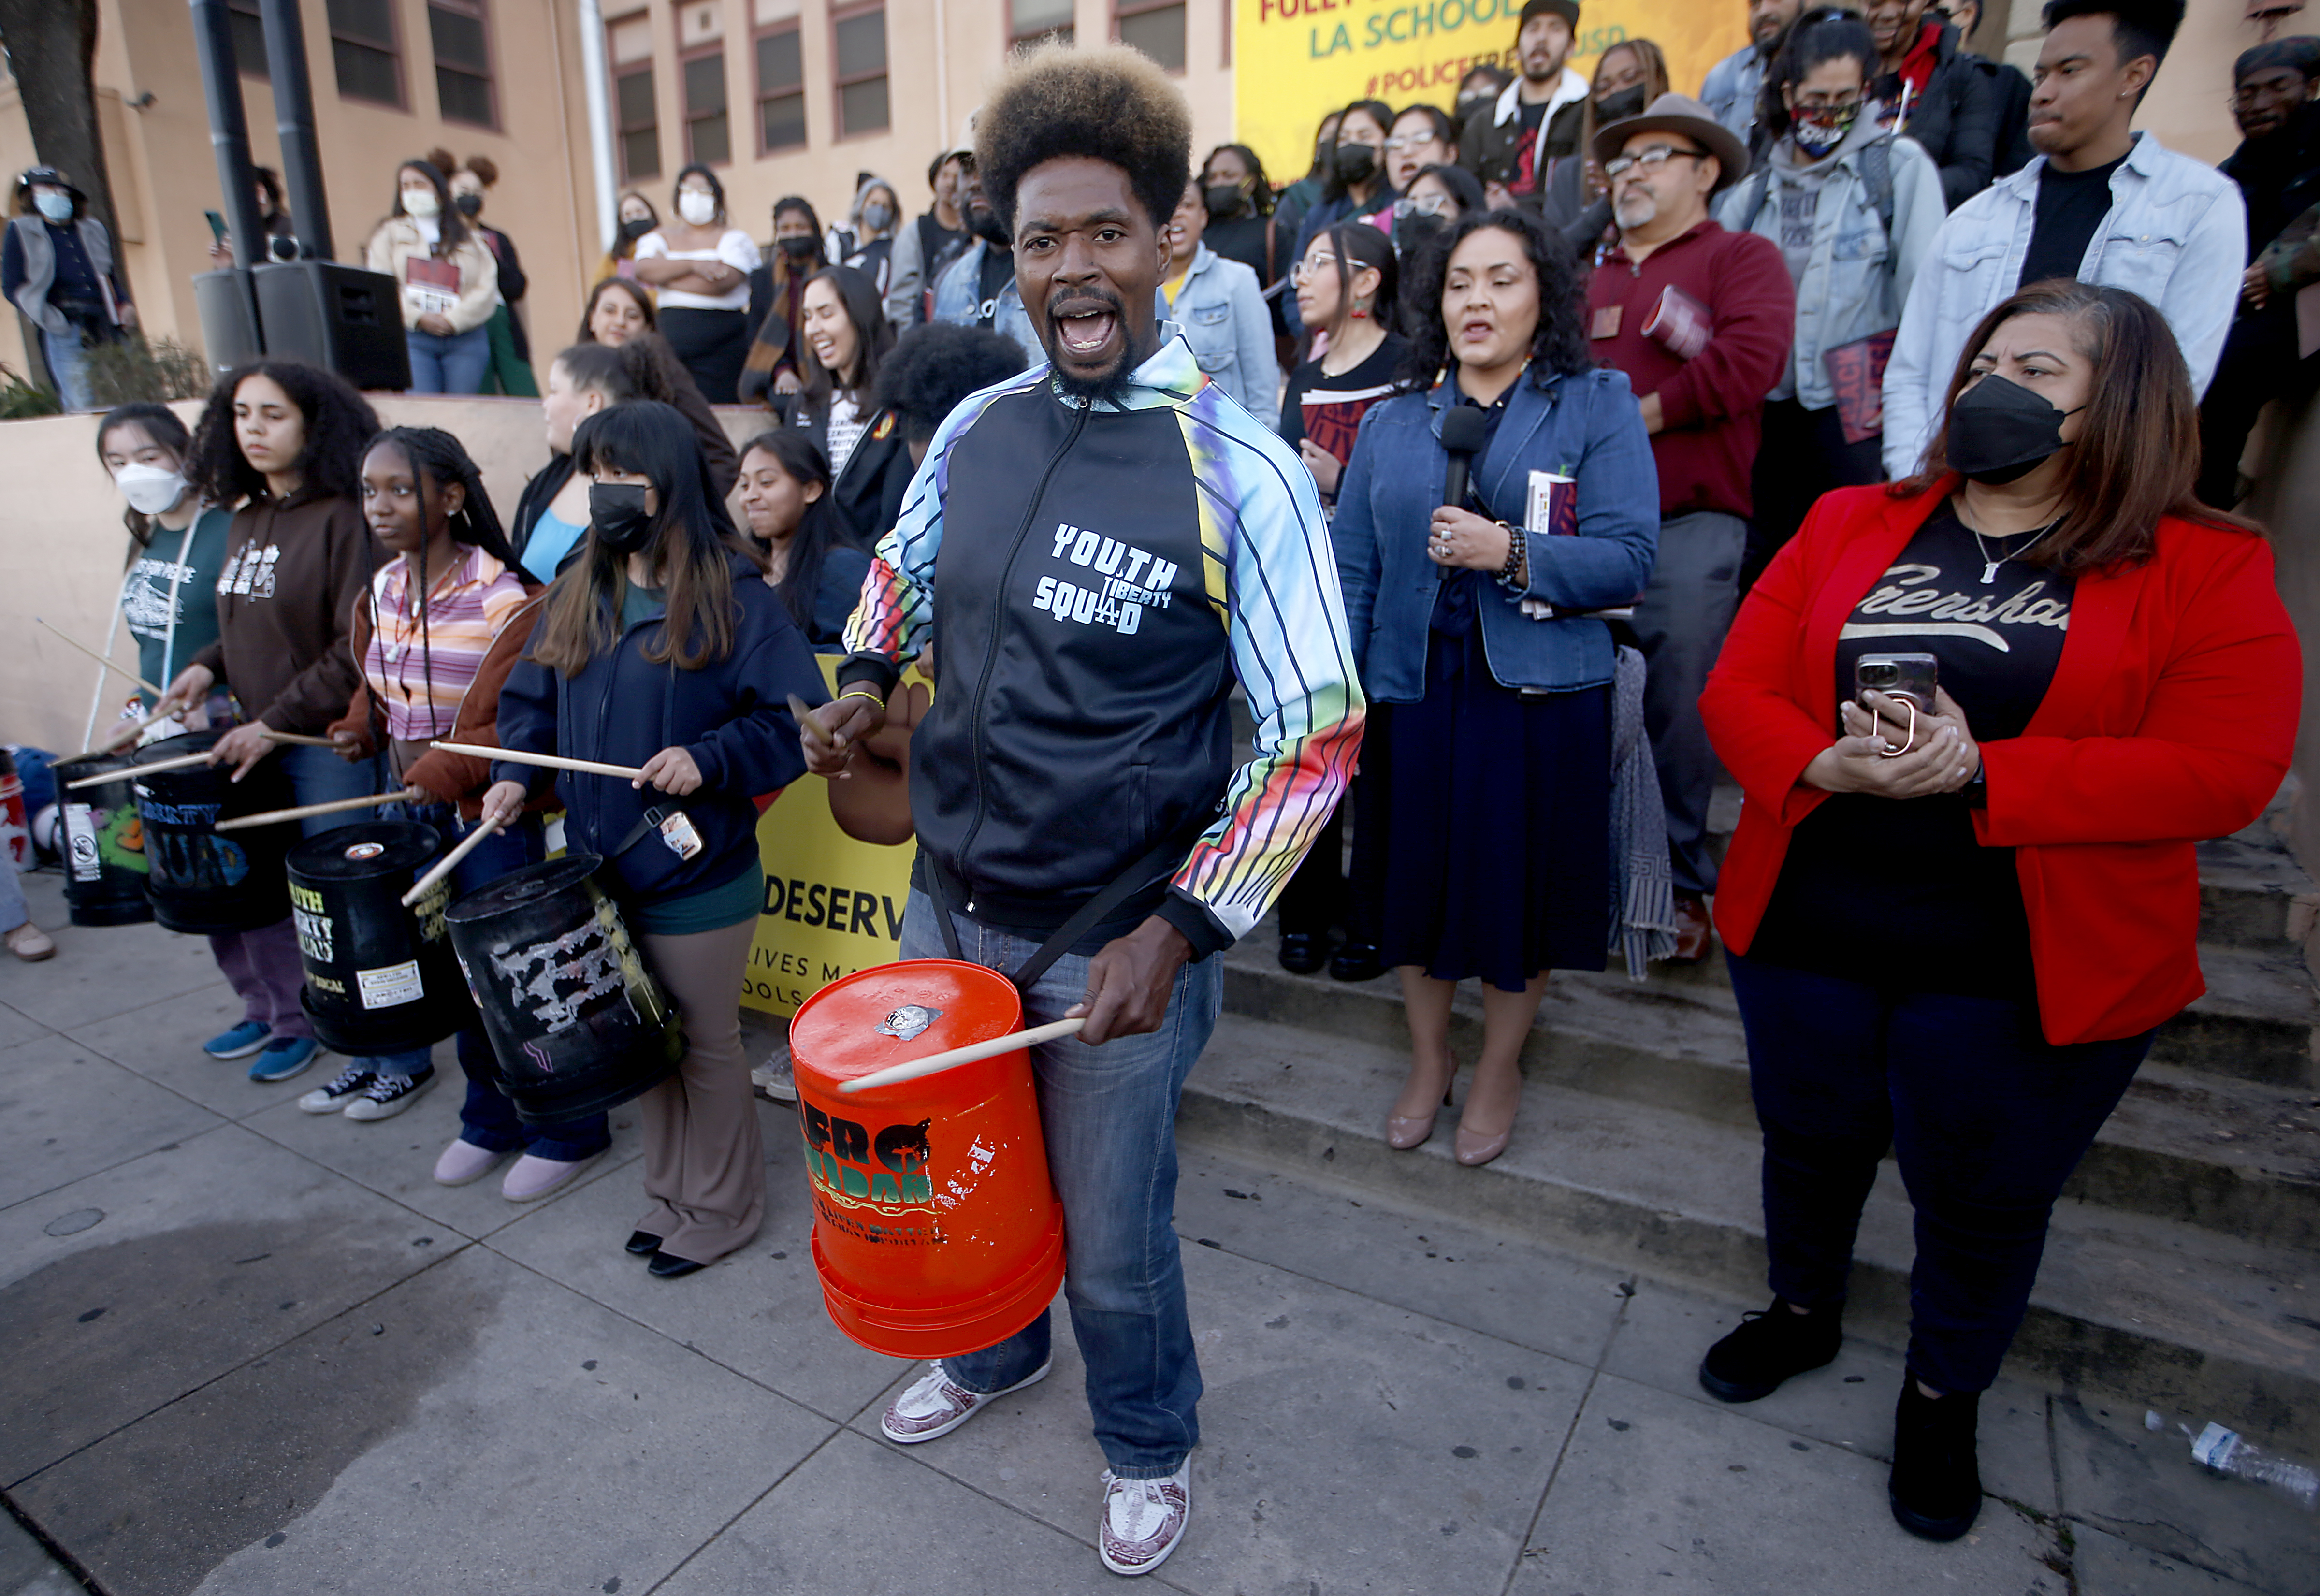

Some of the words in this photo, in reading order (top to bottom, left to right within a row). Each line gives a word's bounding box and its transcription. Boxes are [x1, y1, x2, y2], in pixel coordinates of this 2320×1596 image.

[1311, 22, 1352, 58] LA
[1051, 523, 1178, 591] YOUTH
[1032, 575, 1142, 635] SQUAD
[761, 874, 906, 942] DESERV
[747, 947, 809, 976] IVES
